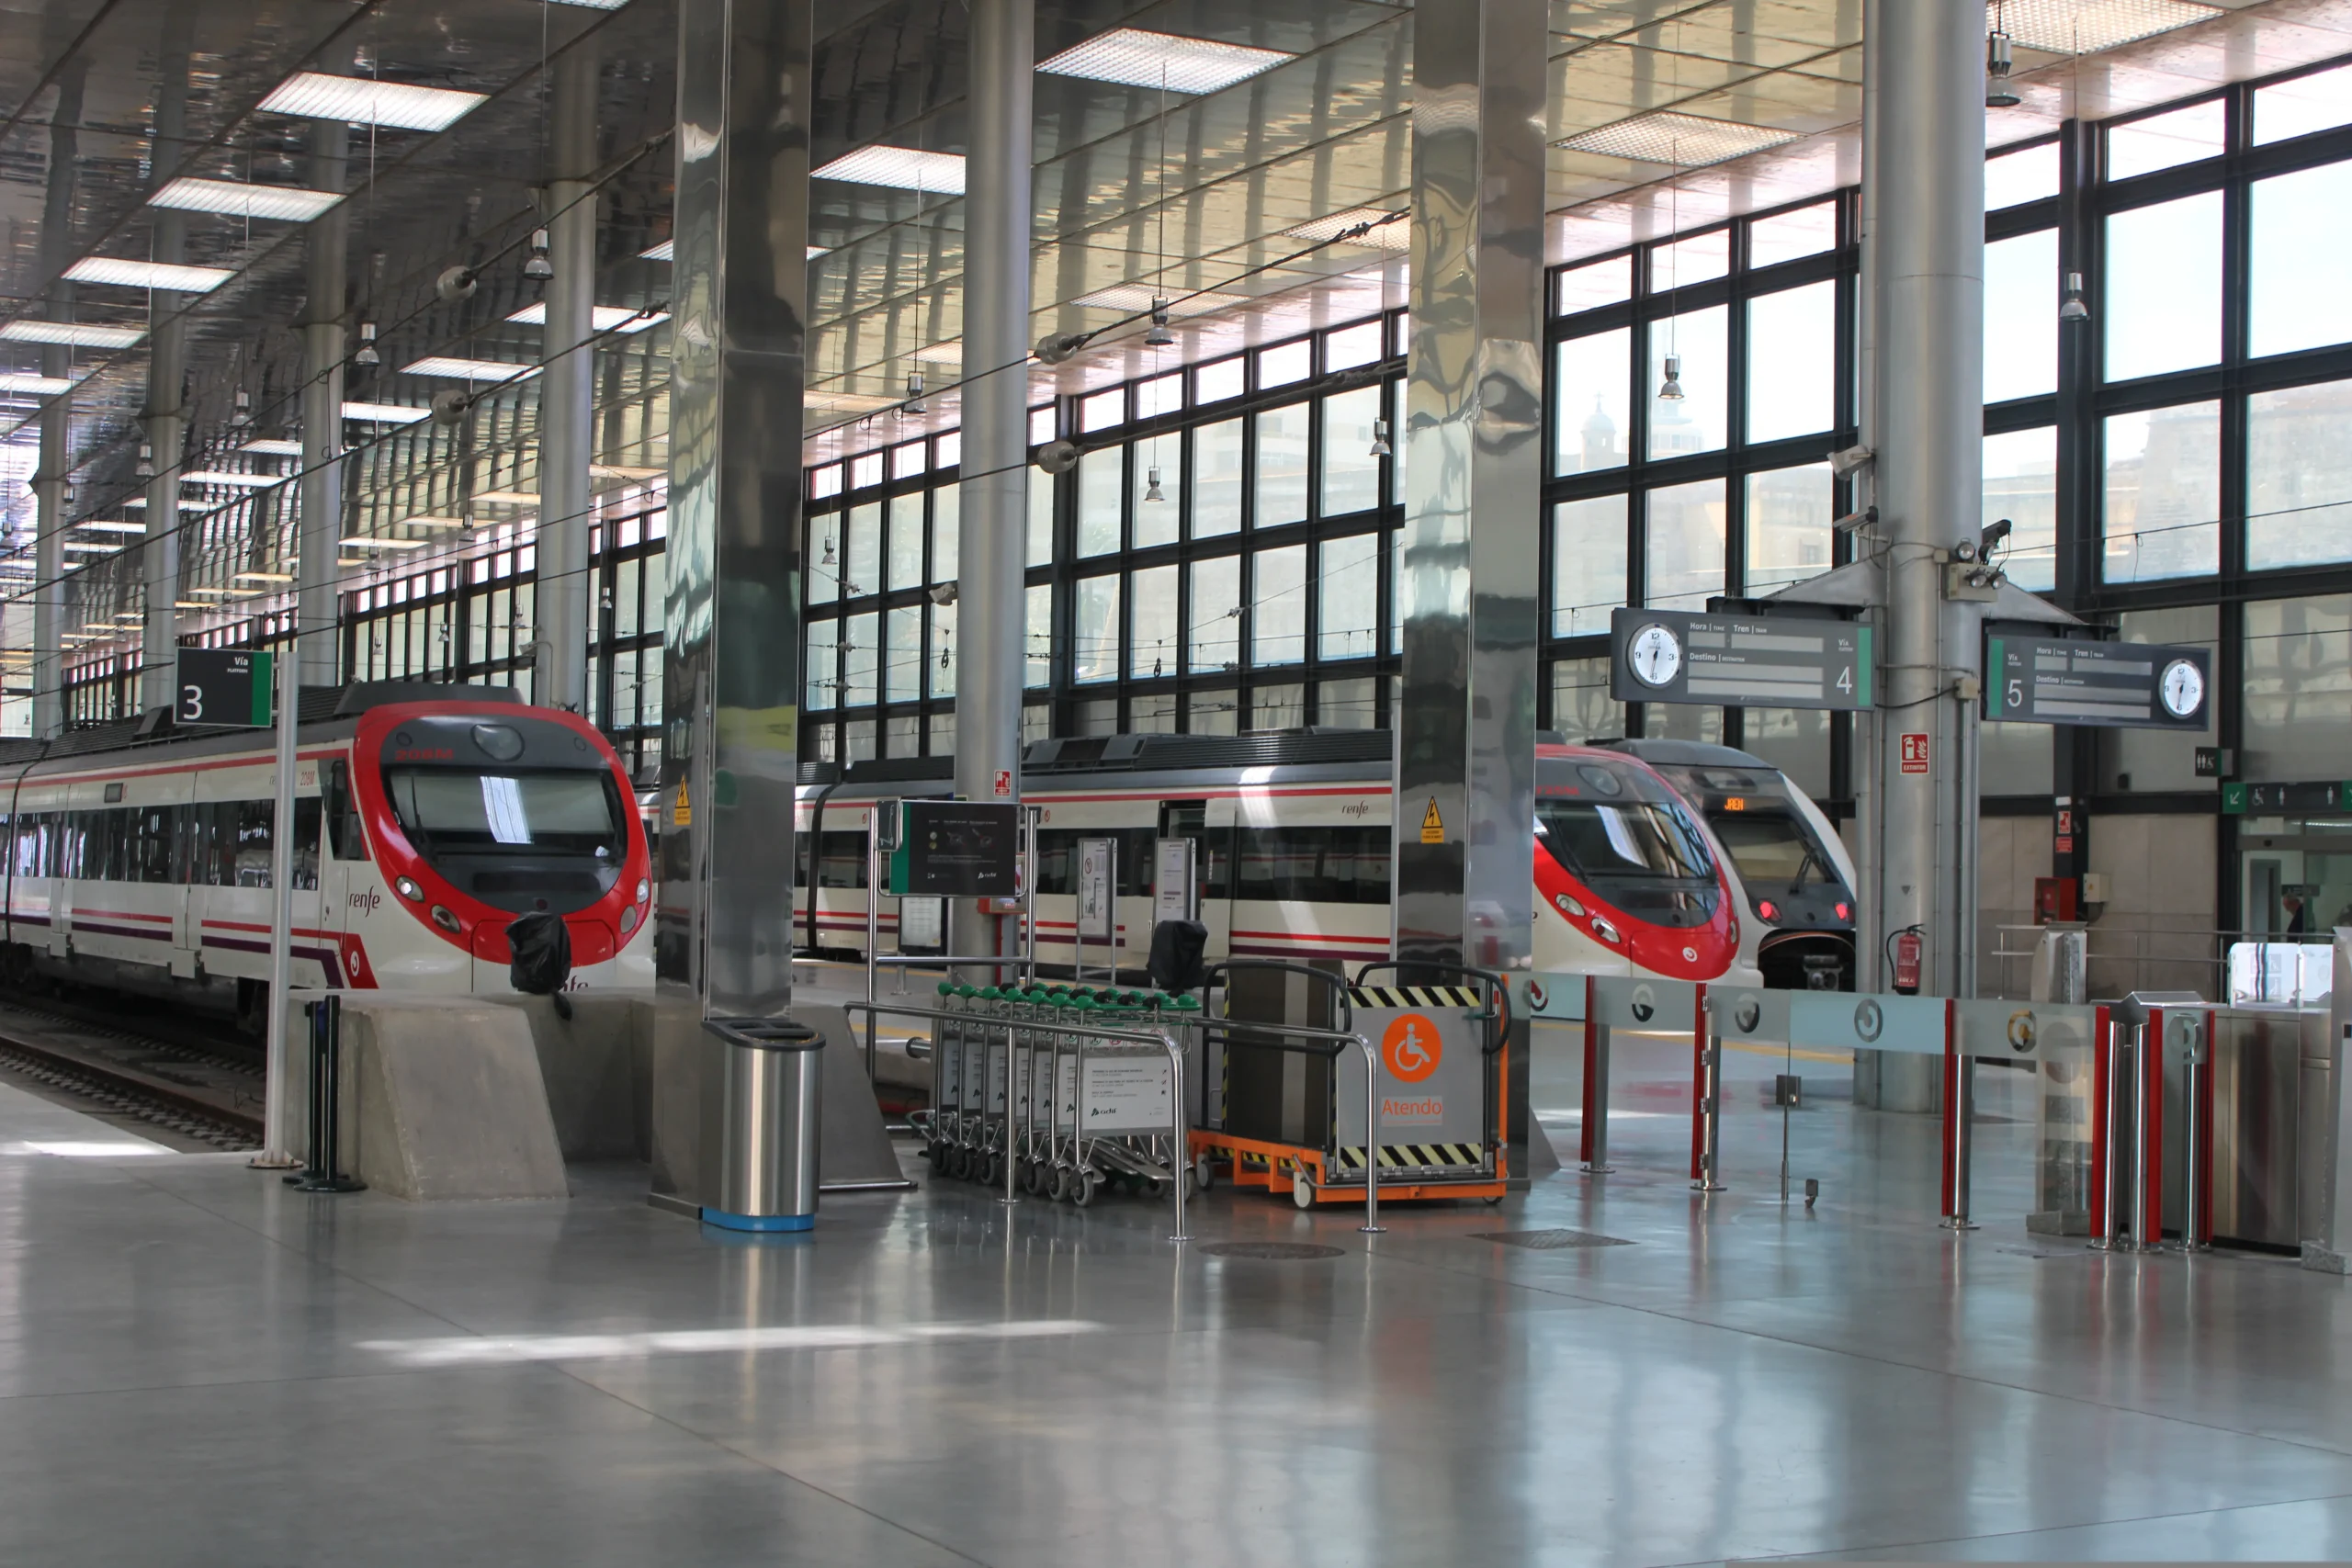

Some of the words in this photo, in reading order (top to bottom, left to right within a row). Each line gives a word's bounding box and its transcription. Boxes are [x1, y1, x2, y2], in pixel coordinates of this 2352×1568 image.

[1690, 622, 1707, 631] Hora
[1733, 624, 1749, 633] Tren
[1651, 632, 1660, 640] 12
[1635, 651, 1642, 660] 9
[1668, 653, 1675, 661] 3
[1690, 652, 1716, 661] Destino
[2036, 647, 2052, 655] Hora
[2075, 649, 2088, 658] Tren
[233, 656, 249, 666] Vía
[1836, 665, 1853, 695] 4
[2007, 679, 2023, 708] 5
[184, 684, 203, 720] 3
[1341, 799, 1369, 819] renfe
[348, 886, 380, 918] renfe
[1100, 1107, 1118, 1115] adif
[1382, 1097, 1442, 1116] Atendo
